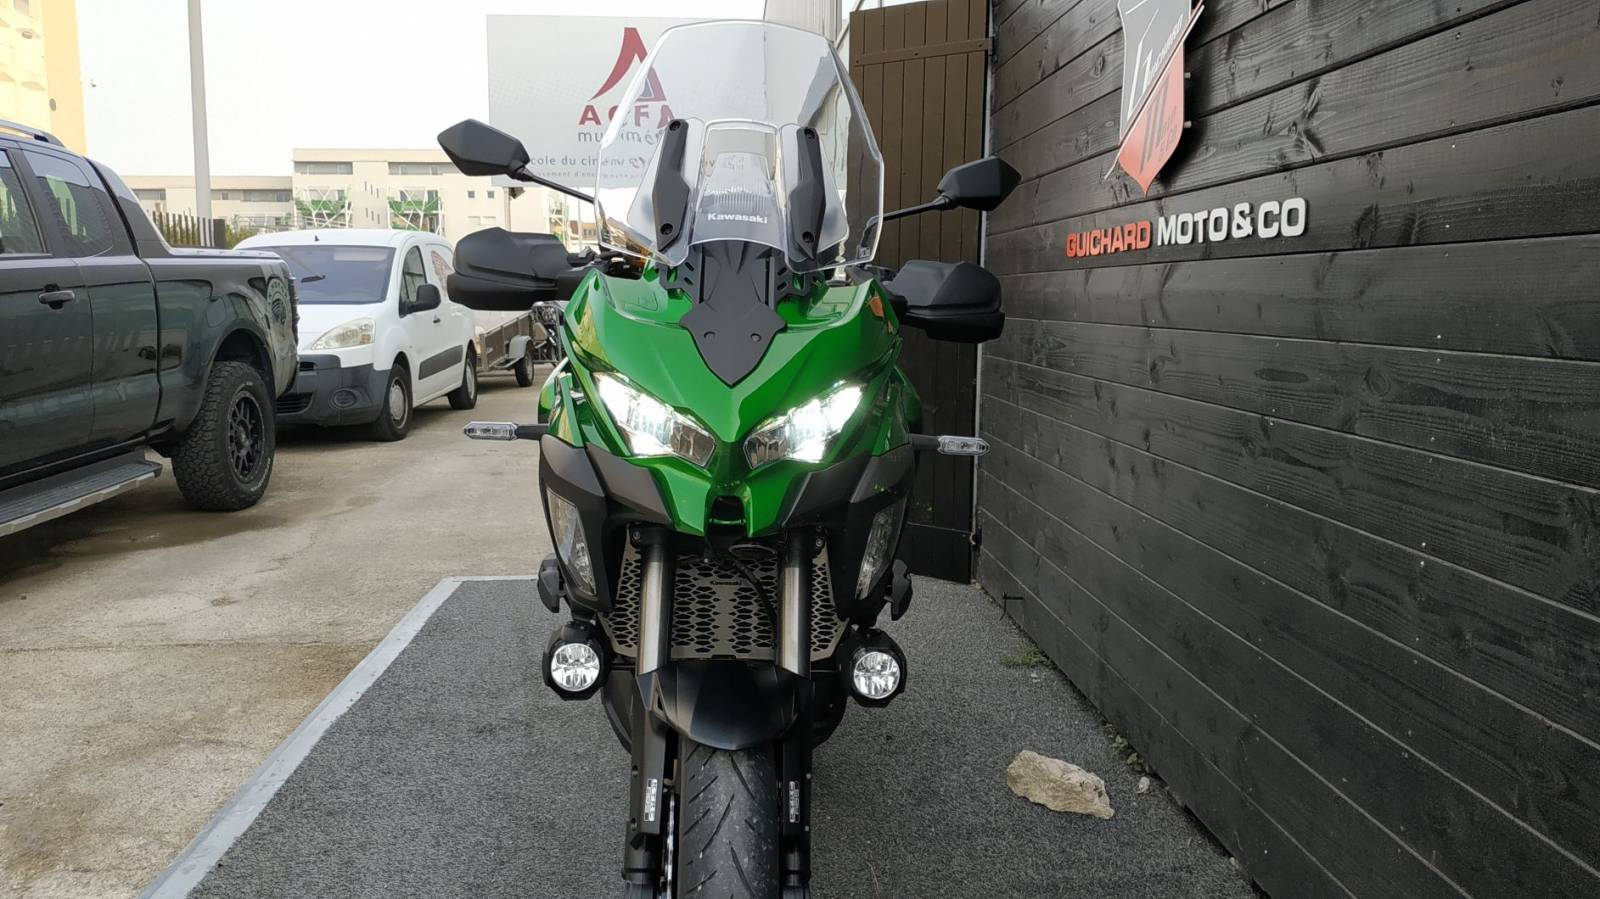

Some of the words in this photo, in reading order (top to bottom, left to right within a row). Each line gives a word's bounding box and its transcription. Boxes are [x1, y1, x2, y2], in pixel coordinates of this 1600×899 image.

[529, 154, 556, 166] cole
[561, 154, 576, 166] du
[707, 212, 769, 224] Kawasaki
[1067, 220, 1152, 257] GUICHARD
[1157, 197, 1307, 246] MOTO&CO
